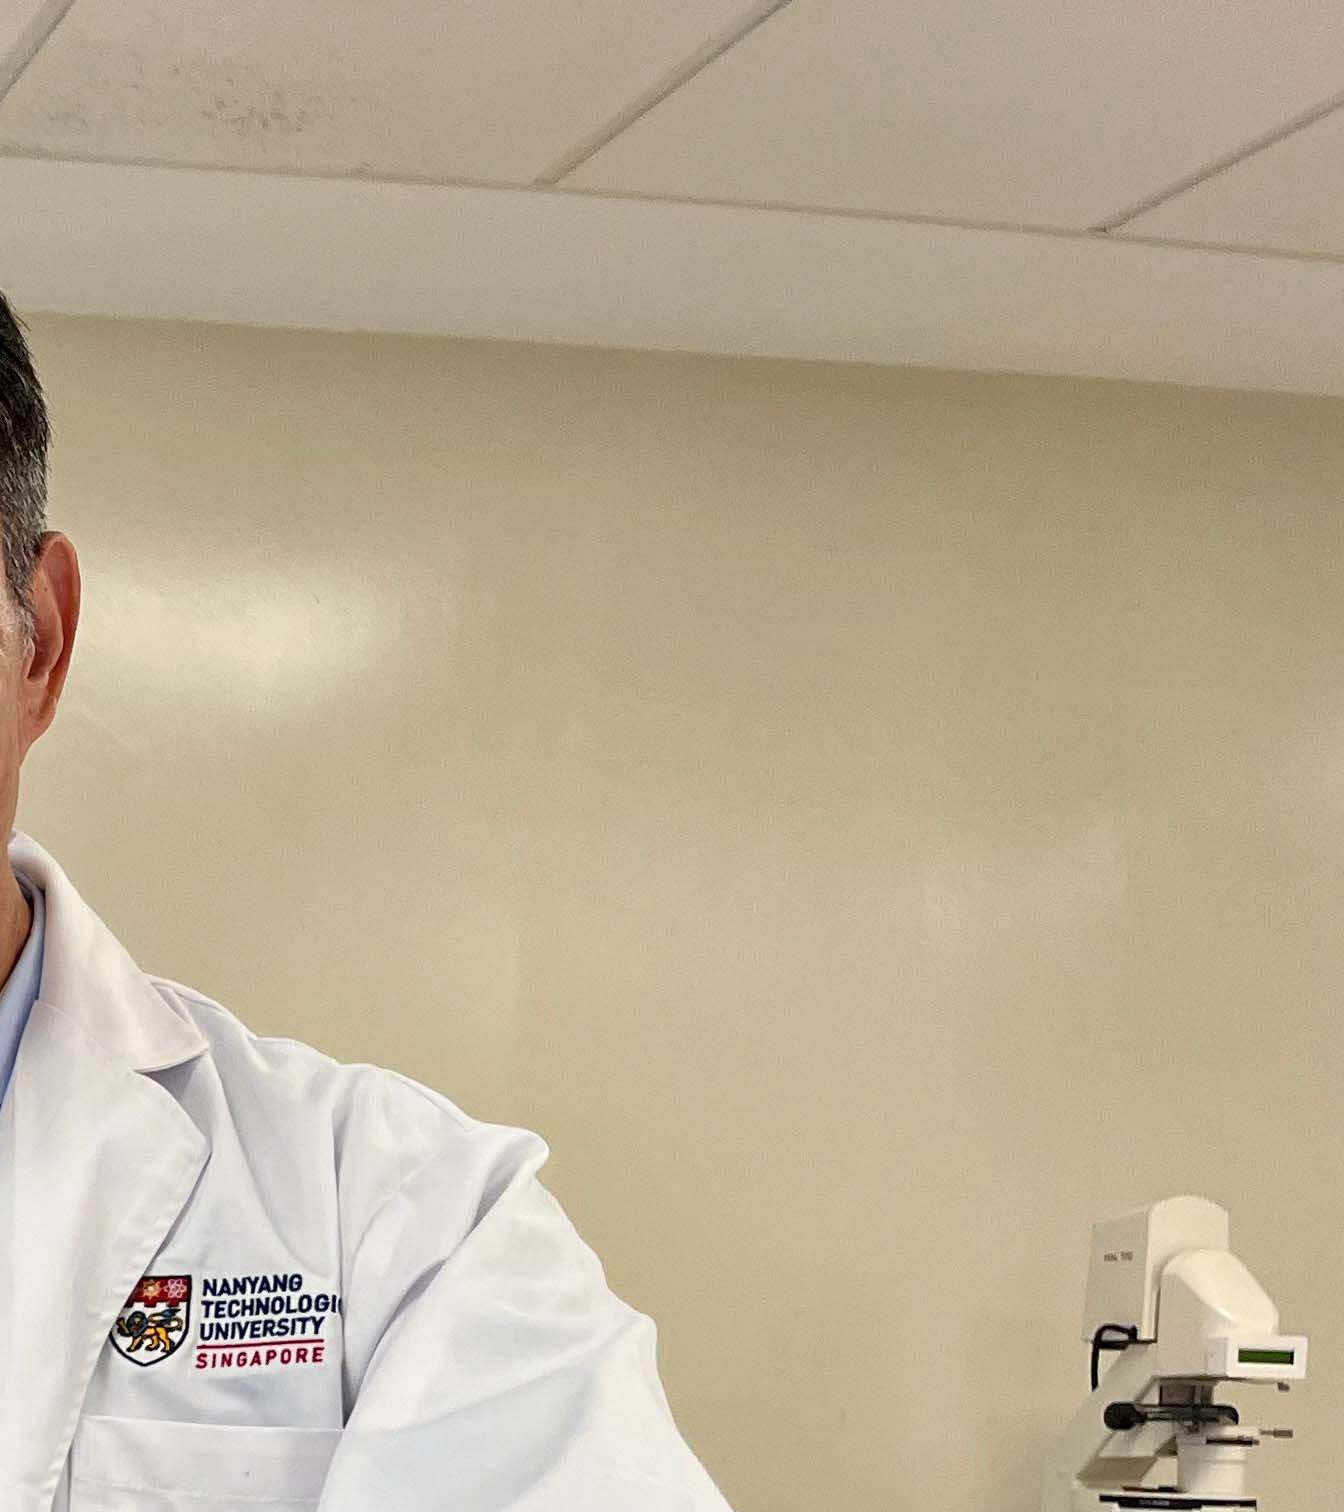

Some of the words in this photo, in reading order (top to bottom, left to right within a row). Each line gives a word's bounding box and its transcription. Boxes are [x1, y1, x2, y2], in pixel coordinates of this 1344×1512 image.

[202, 1274, 303, 1297] NANYANG
[199, 1316, 325, 1341] UNIVERSITY
[194, 1347, 325, 1369] SINGAPORE
